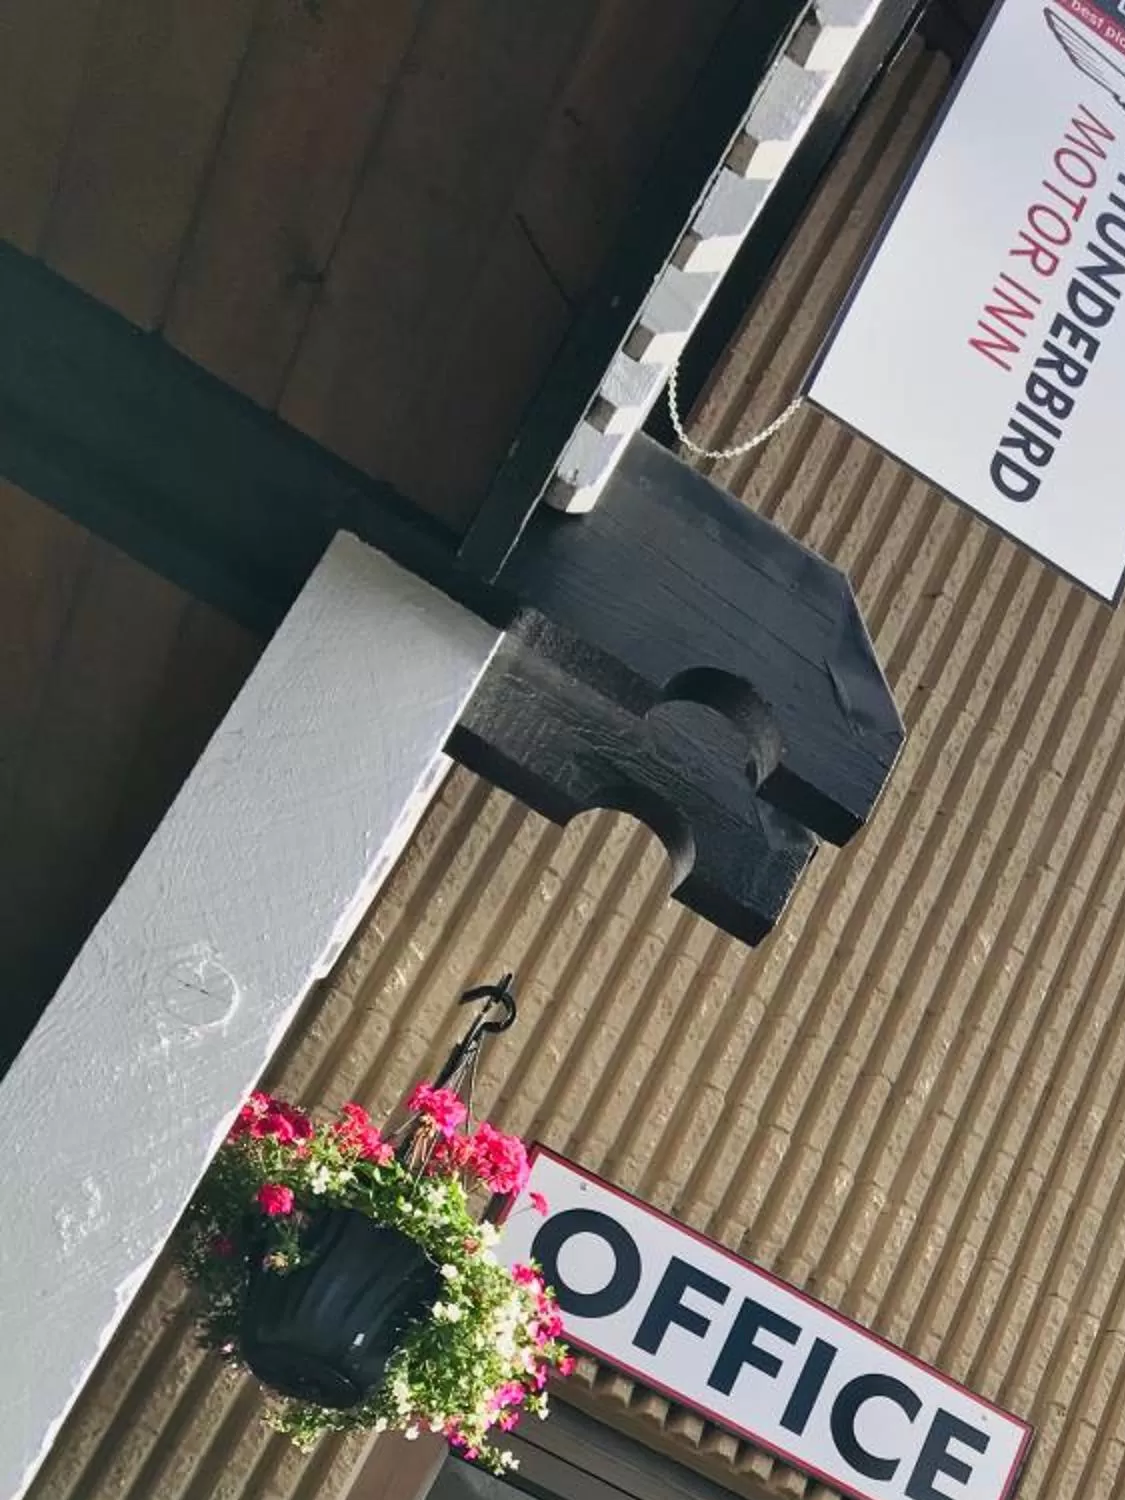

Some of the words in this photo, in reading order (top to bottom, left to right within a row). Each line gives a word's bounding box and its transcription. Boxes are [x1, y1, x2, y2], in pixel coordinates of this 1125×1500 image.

[1071, 0, 1105, 30] best
[1009, 103, 1116, 278] MOTOR
[967, 272, 1042, 373] INN
